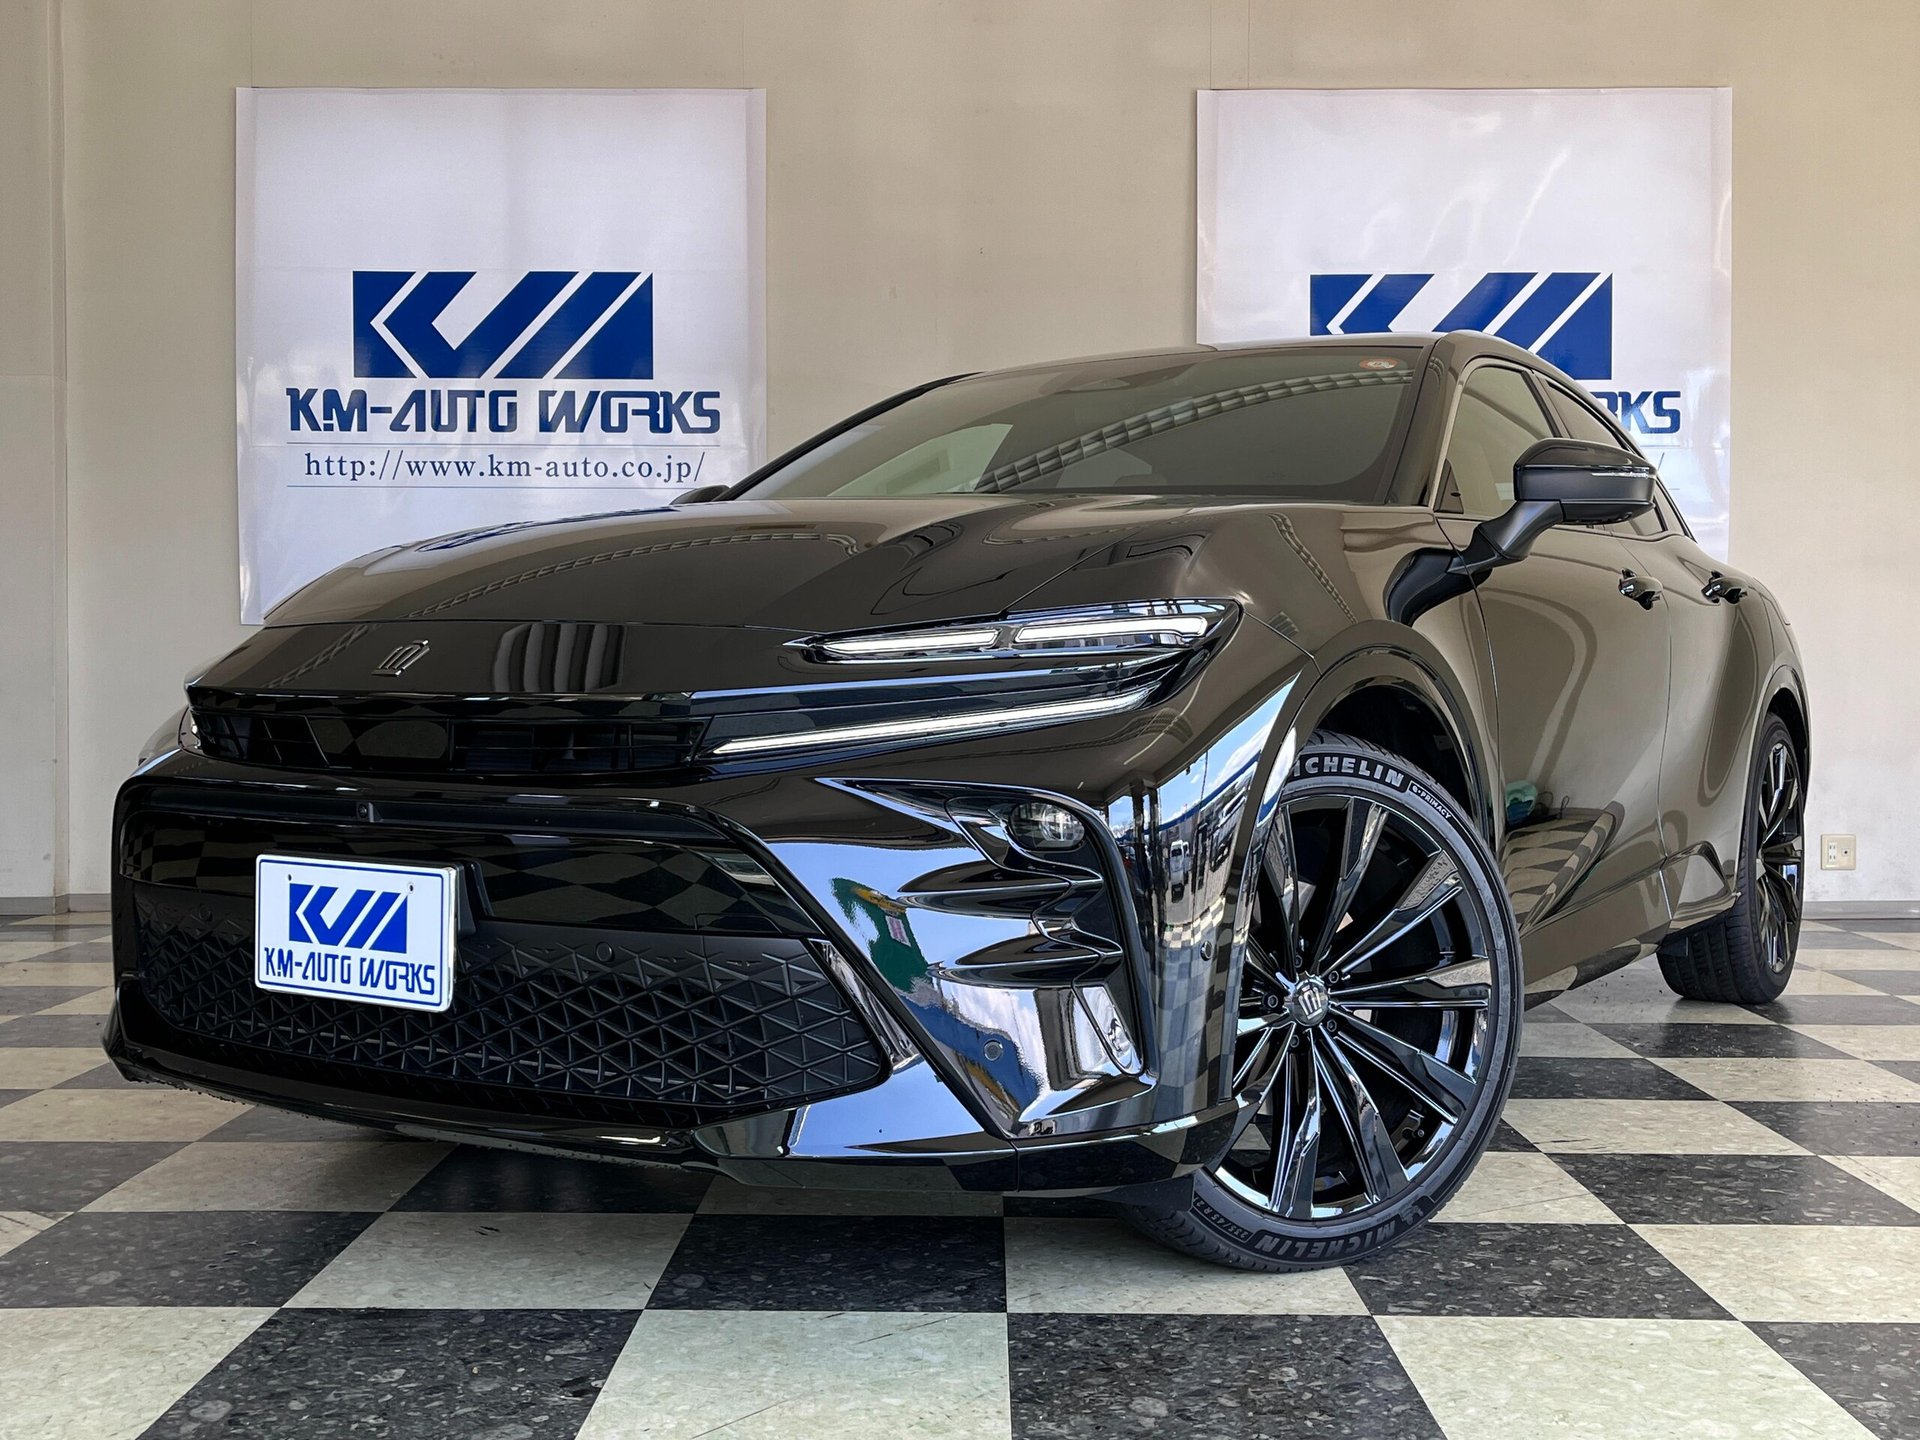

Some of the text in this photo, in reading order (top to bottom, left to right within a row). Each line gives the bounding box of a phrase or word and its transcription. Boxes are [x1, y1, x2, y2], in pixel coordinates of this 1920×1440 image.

[285, 387, 721, 434] KM-AUTO WORKS
[304, 449, 706, 482] http://www.km-auto.co.jp/
[1293, 756, 1404, 788] ICHELIN
[264, 947, 436, 996] KM-AUTO WORKS
[1254, 1219, 1397, 1259] MICHELIN
